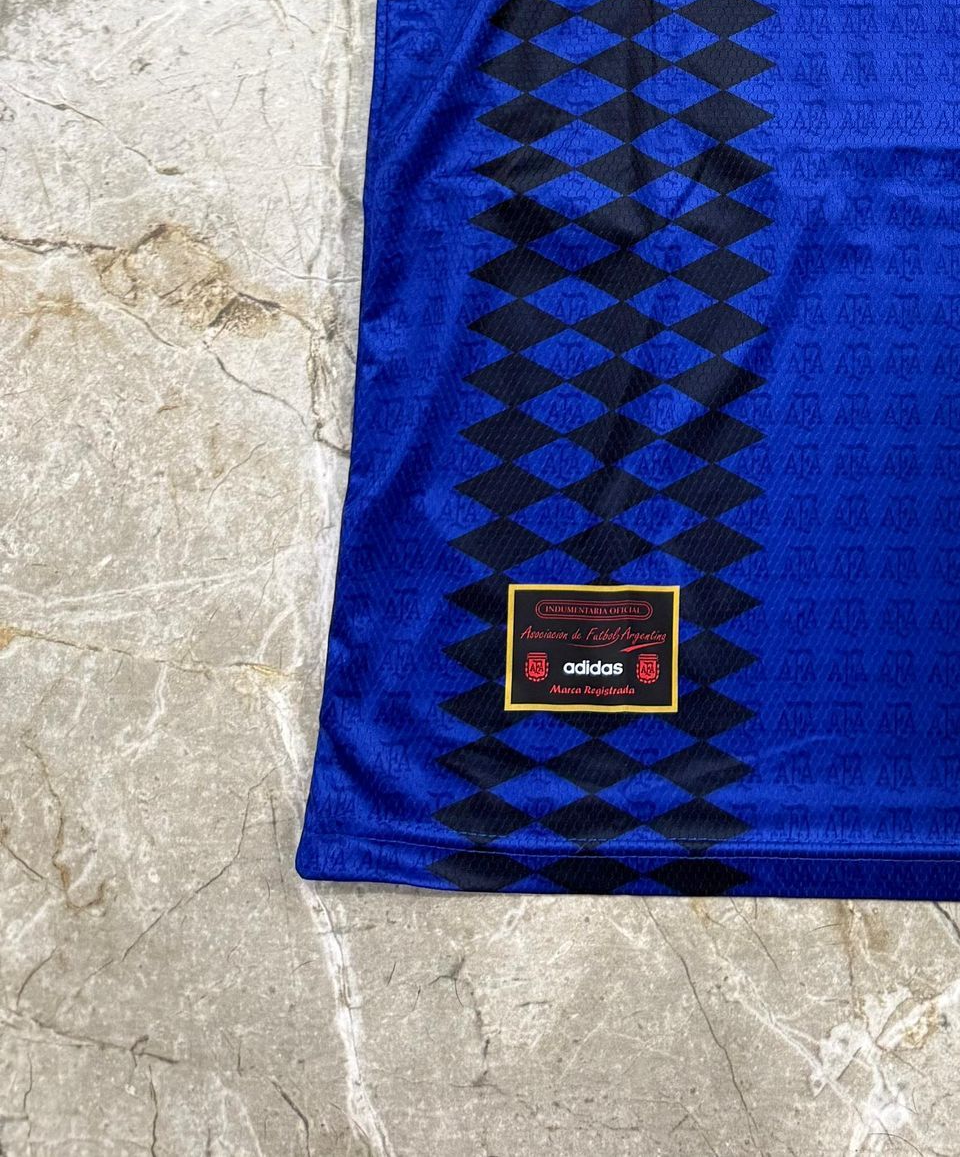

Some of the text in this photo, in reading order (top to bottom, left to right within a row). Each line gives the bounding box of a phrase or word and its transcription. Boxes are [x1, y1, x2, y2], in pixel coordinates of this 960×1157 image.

[563, 660, 624, 675] adidas
[549, 684, 636, 698] Marca Registrada
